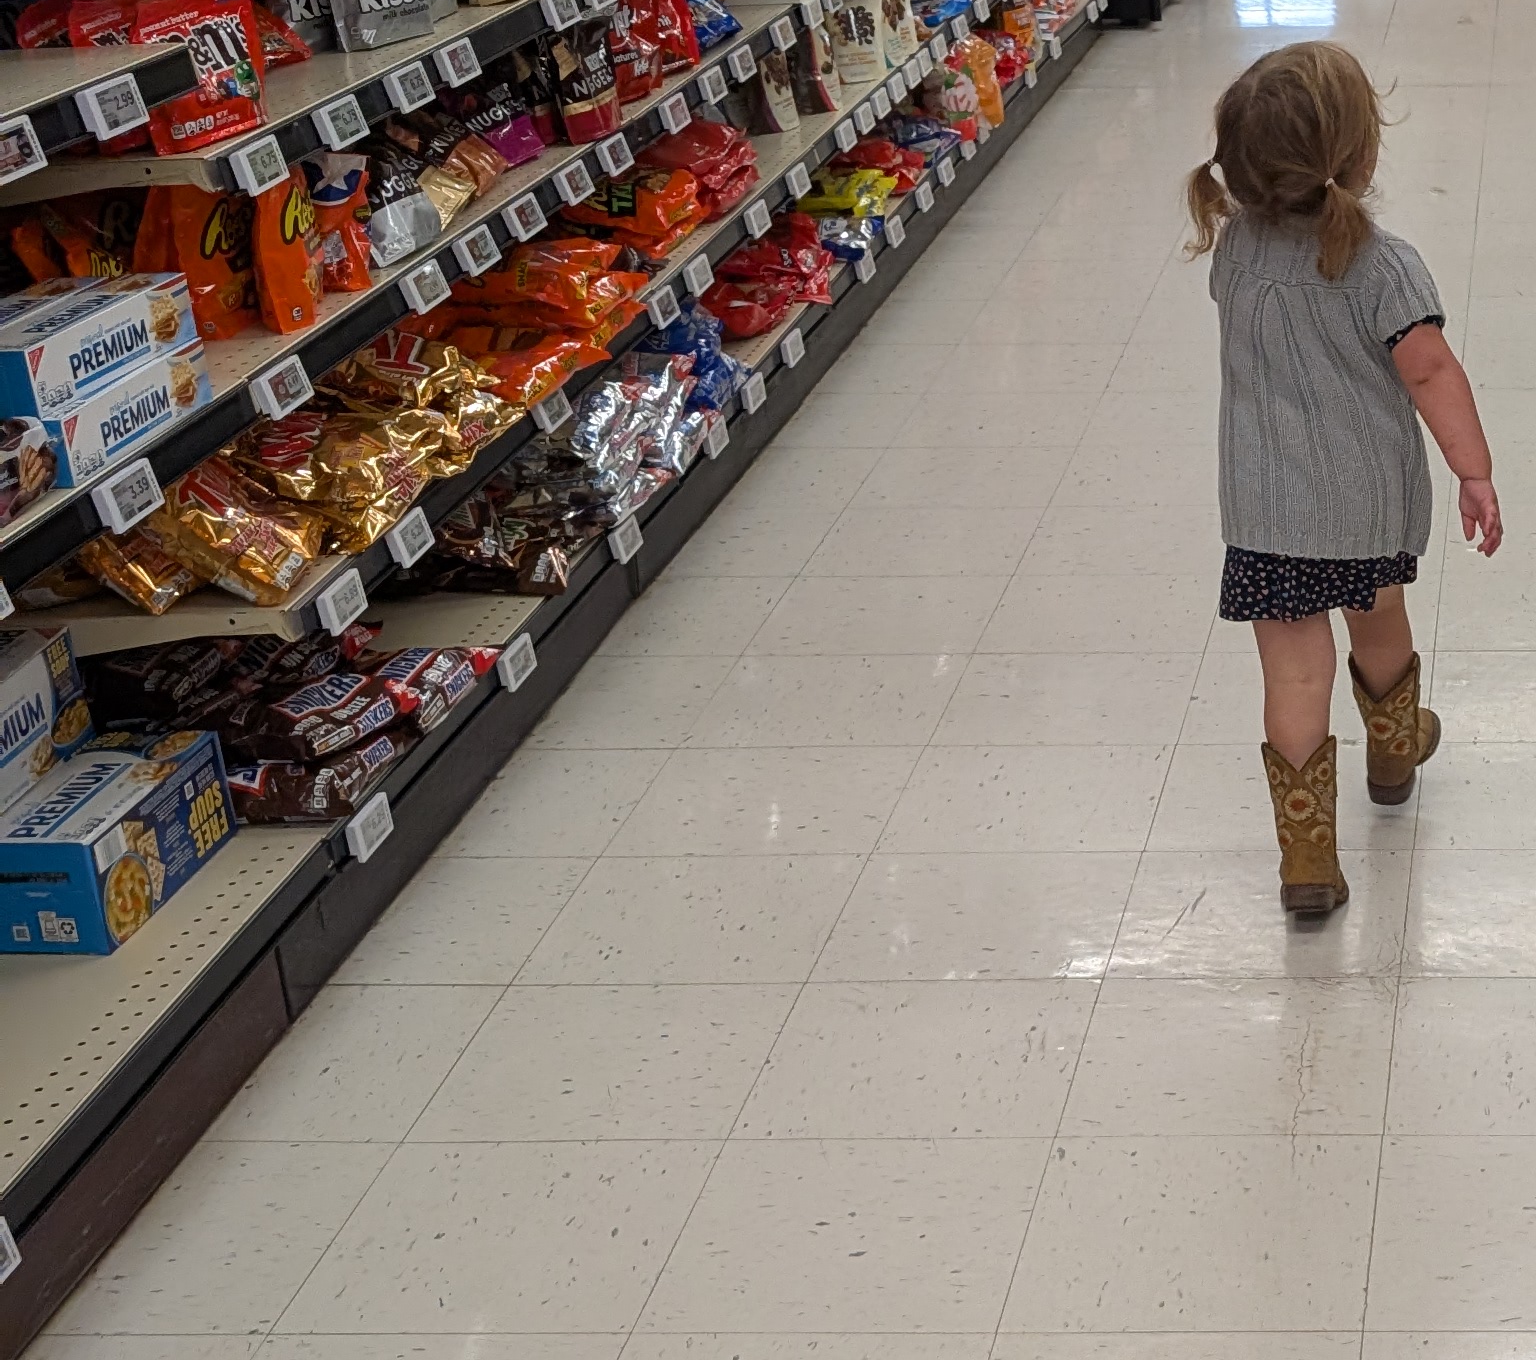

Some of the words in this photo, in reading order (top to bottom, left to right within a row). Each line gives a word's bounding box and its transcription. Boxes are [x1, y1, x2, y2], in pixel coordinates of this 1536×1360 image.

[382, 9, 398, 21] milk
[399, 4, 430, 19] chocolate
[114, 90, 135, 111] 2.99
[341, 110, 359, 127] 6.75
[259, 151, 278, 169] 6.75
[69, 319, 149, 380] PREMIUM
[100, 385, 171, 447] PREMIUM
[129, 476, 150, 500] 3.39
[46, 635, 68, 657] FREE
[50, 653, 70, 678] SOUP
[282, 672, 363, 715] SNICKERS
[360, 698, 395, 732] SNICKERS
[7, 763, 122, 839] PREMIUM
[193, 806, 229, 858] FREE
